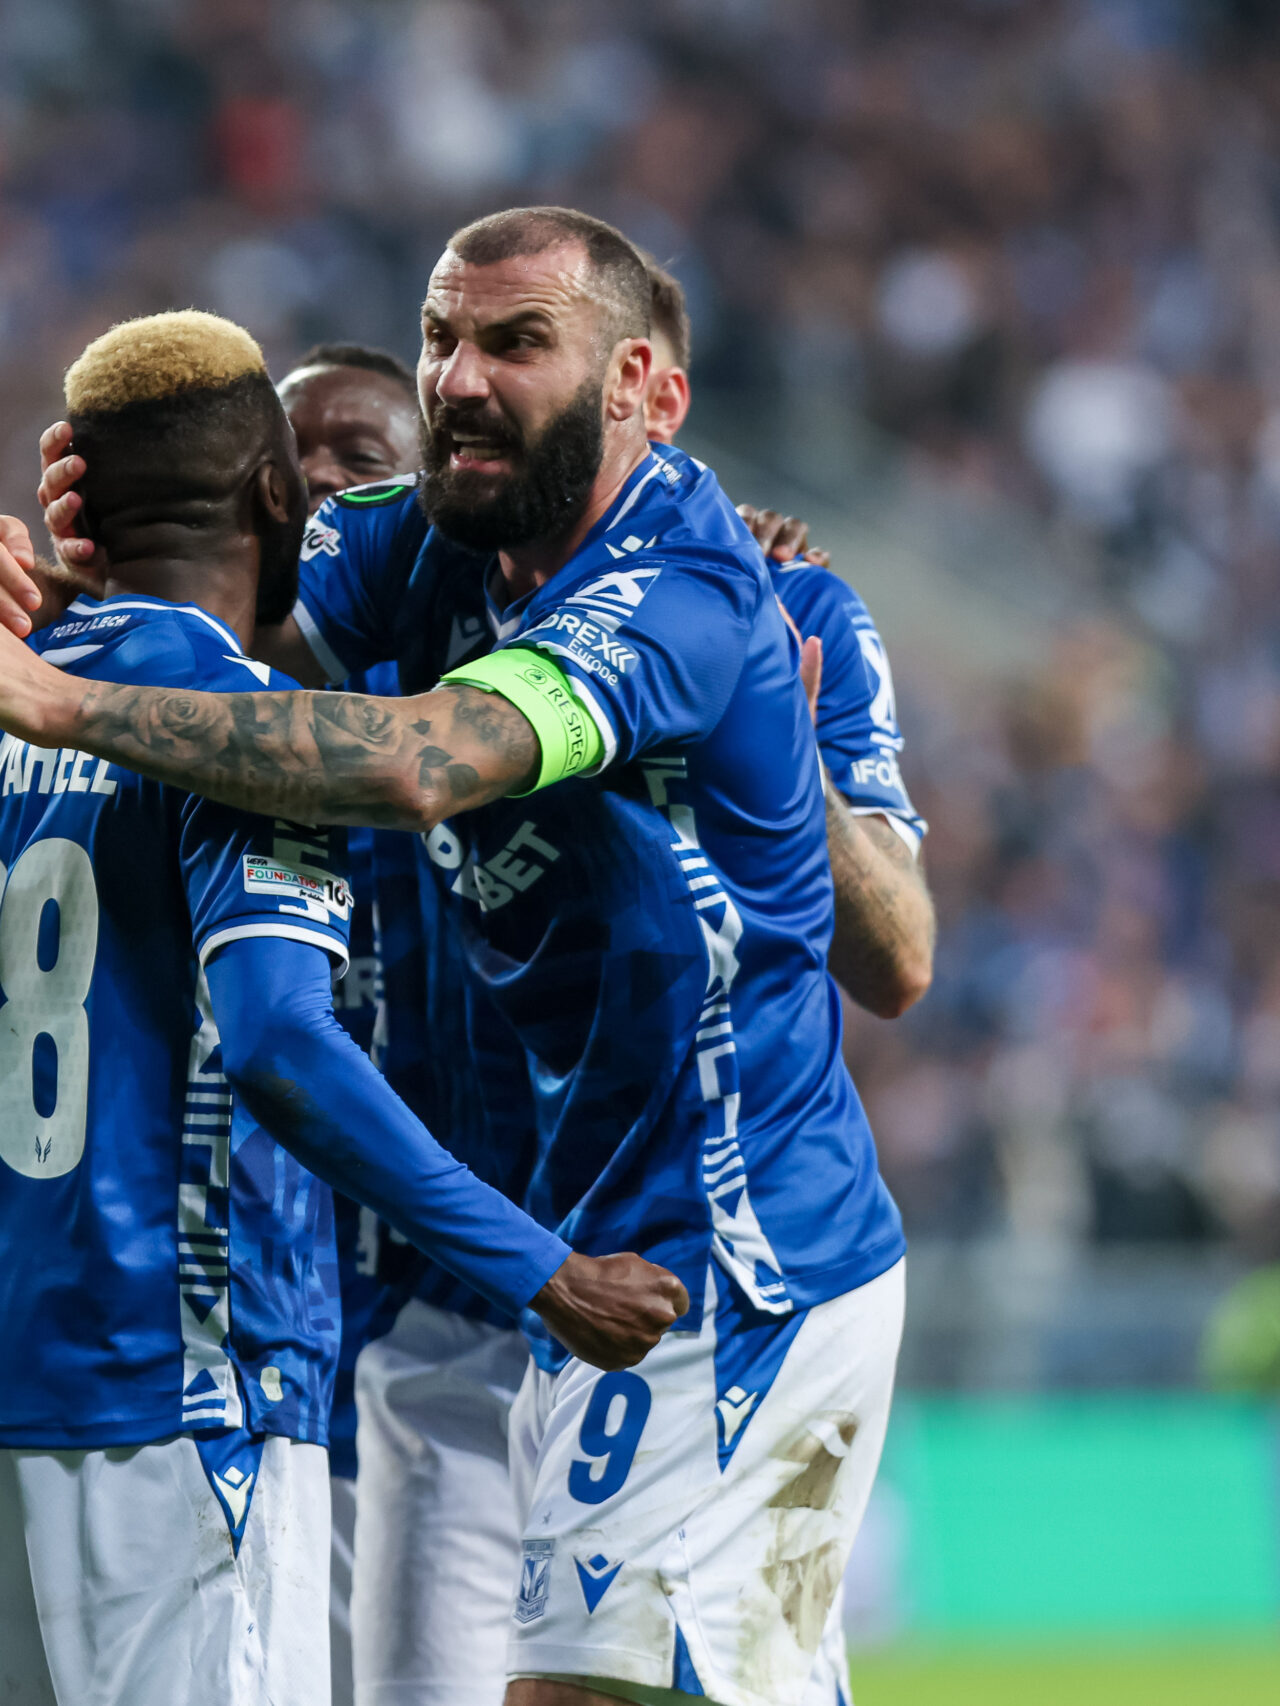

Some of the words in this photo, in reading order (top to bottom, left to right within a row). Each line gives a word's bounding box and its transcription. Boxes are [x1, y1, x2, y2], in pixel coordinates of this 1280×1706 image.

[88, 614, 132, 631] LECH
[568, 638, 618, 687] Europe
[548, 688, 585, 773] RESPECT
[247, 857, 268, 866] UEFA
[247, 869, 324, 892] FOUNDATION
[325, 879, 346, 907] 10
[568, 1371, 652, 1504] 9
